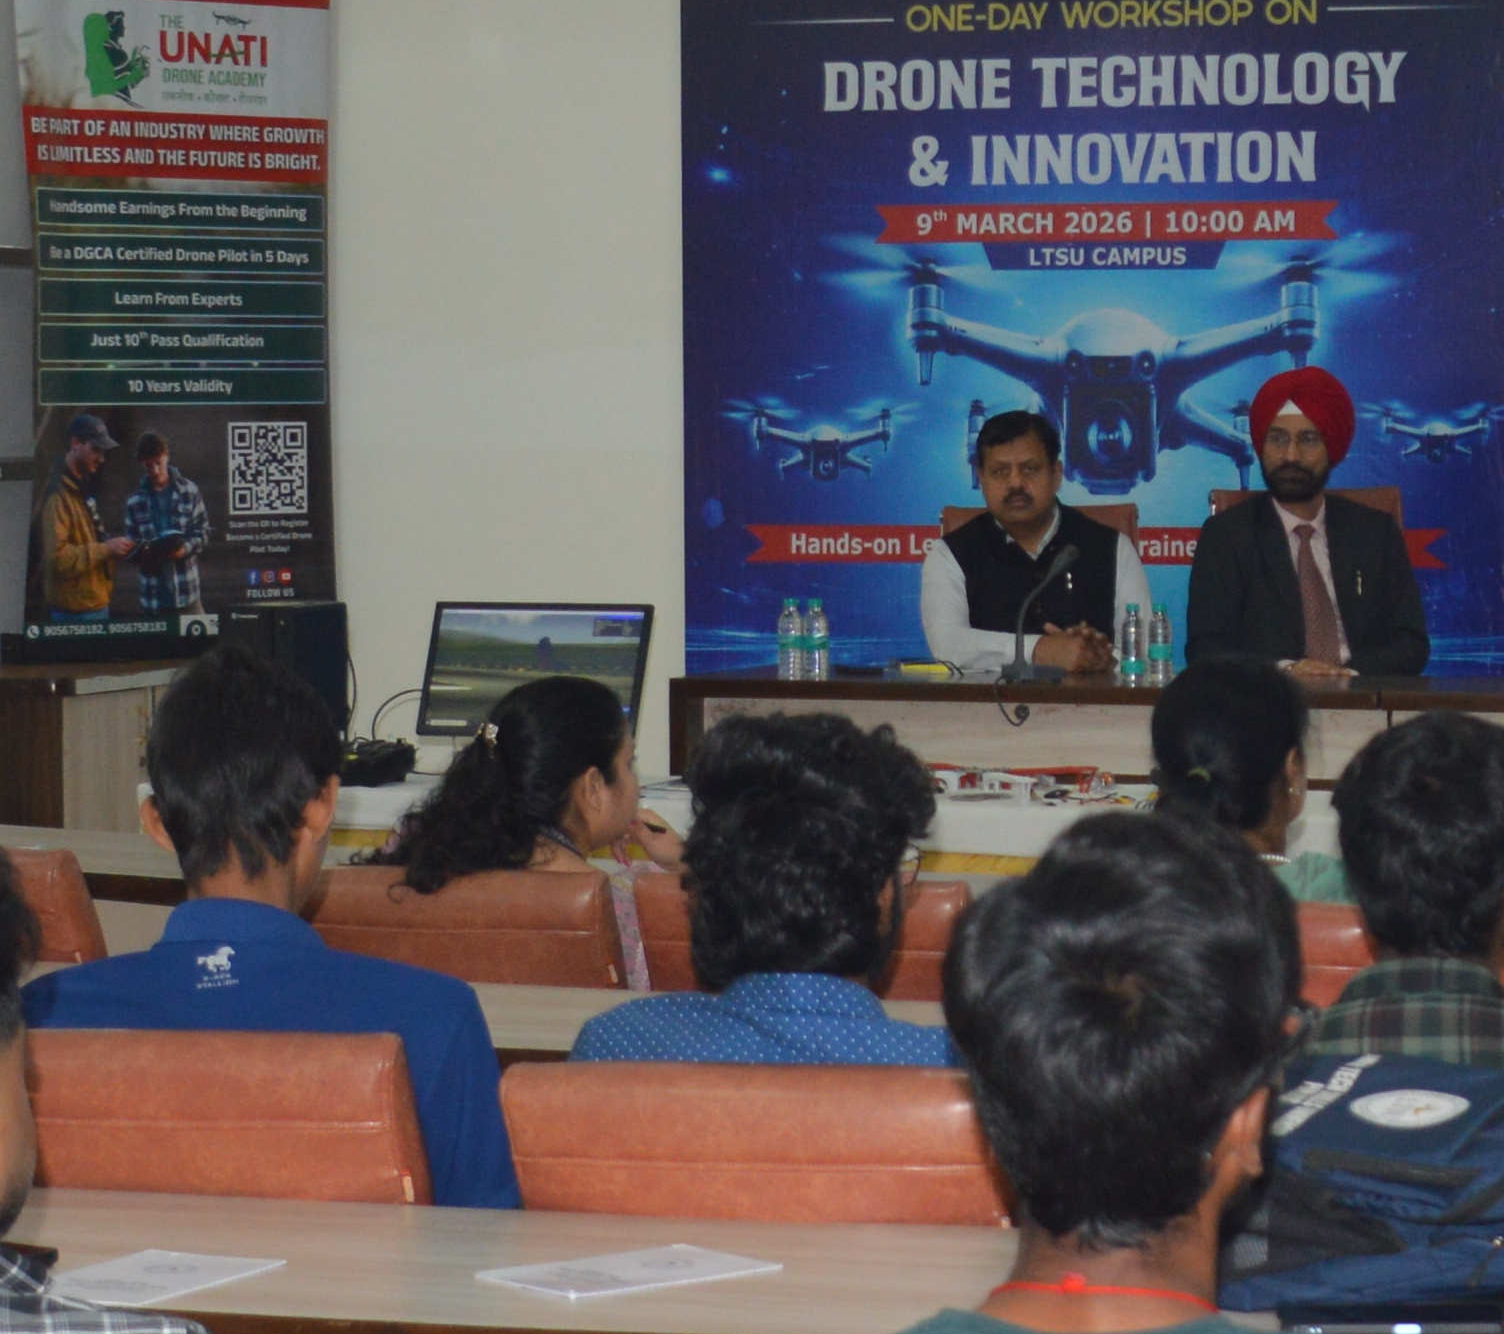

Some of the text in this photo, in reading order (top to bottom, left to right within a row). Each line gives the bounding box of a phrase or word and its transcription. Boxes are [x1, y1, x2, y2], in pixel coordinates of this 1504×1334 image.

[159, 14, 184, 29] THE
[905, 2, 1049, 32] ONE-DAY
[159, 30, 268, 67] UNATI
[163, 68, 267, 88] DRONE ACADEMY
[823, 50, 1408, 112] DRONE TECHNOLOGY
[31, 117, 324, 145] BE PART OF AN INDUSTRY WHERE GROWTH
[37, 144, 321, 171] IS LIMITLESS AND THE FUTURE IS BRIGHT.
[908, 130, 1317, 187] & INNOVATION
[50, 199, 307, 222] Handsome Earnings From the Beginning
[956, 212, 1054, 235] MARCH
[1064, 212, 1133, 234] 2026
[1165, 210, 1245, 233] 10:00
[1253, 209, 1296, 233] AM
[74, 246, 113, 260] DGCA
[116, 246, 174, 261] Certified
[176, 248, 216, 262] Drone
[218, 249, 247, 263] Pilot
[250, 250, 262, 263] in
[265, 251, 273, 263] 5
[276, 251, 310, 266] Days
[1028, 245, 1186, 267] LTSU CAMPUS
[115, 291, 243, 308] Learn From Experts
[91, 334, 122, 347] Just
[150, 334, 180, 347] Pass
[181, 334, 265, 349] Qualification
[128, 379, 233, 395] 10 Years Validity
[791, 533, 901, 555] Hands-on
[1138, 534, 1198, 557] raine
[246, 588, 295, 598] FOLLOW US
